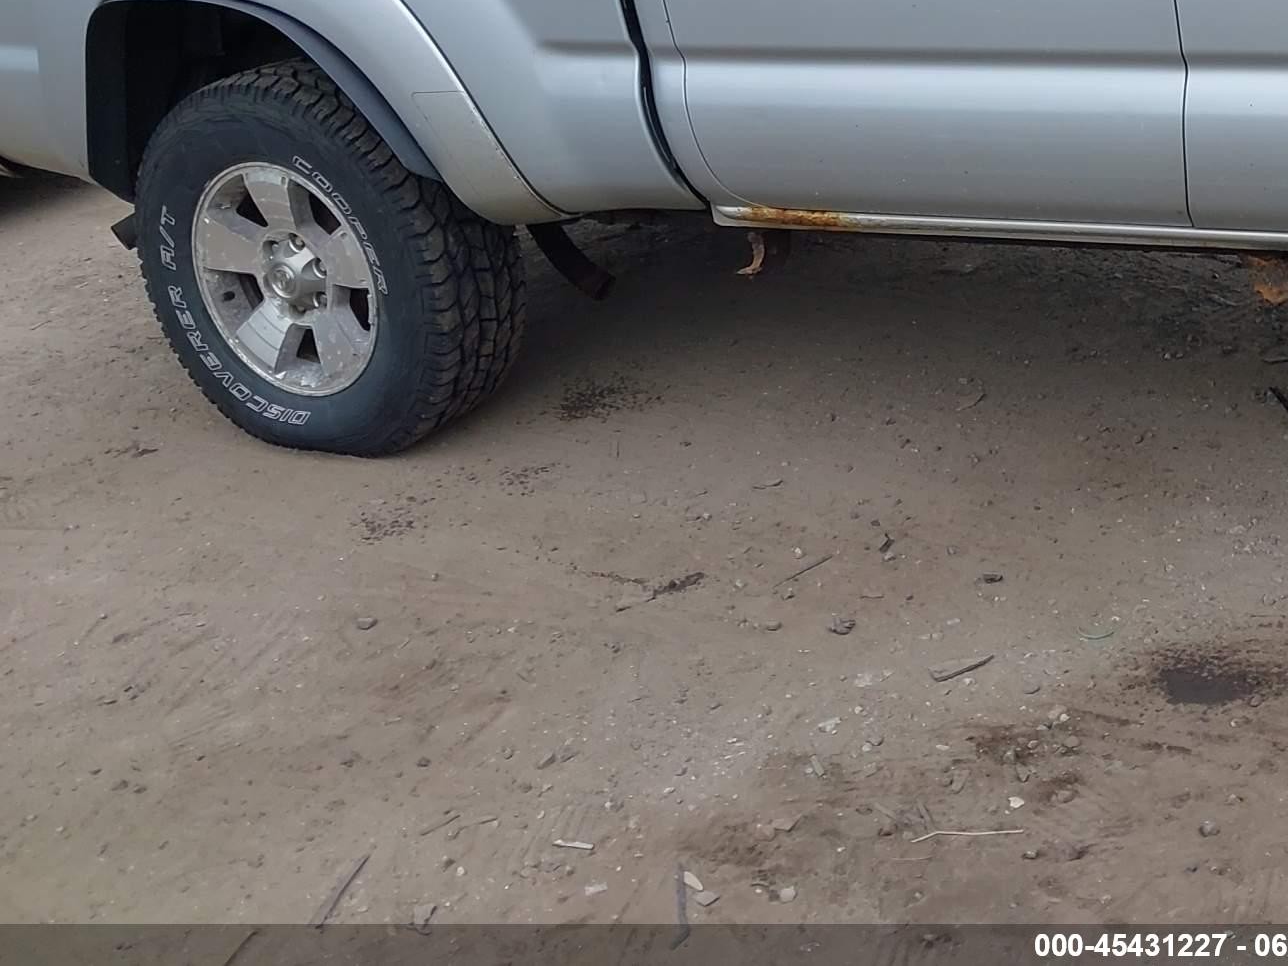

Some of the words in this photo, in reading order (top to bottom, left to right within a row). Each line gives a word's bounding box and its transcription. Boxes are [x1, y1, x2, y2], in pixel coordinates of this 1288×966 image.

[159, 205, 178, 271] A/T
[292, 155, 389, 295] COOPER
[167, 285, 312, 426] DISCOVERER
